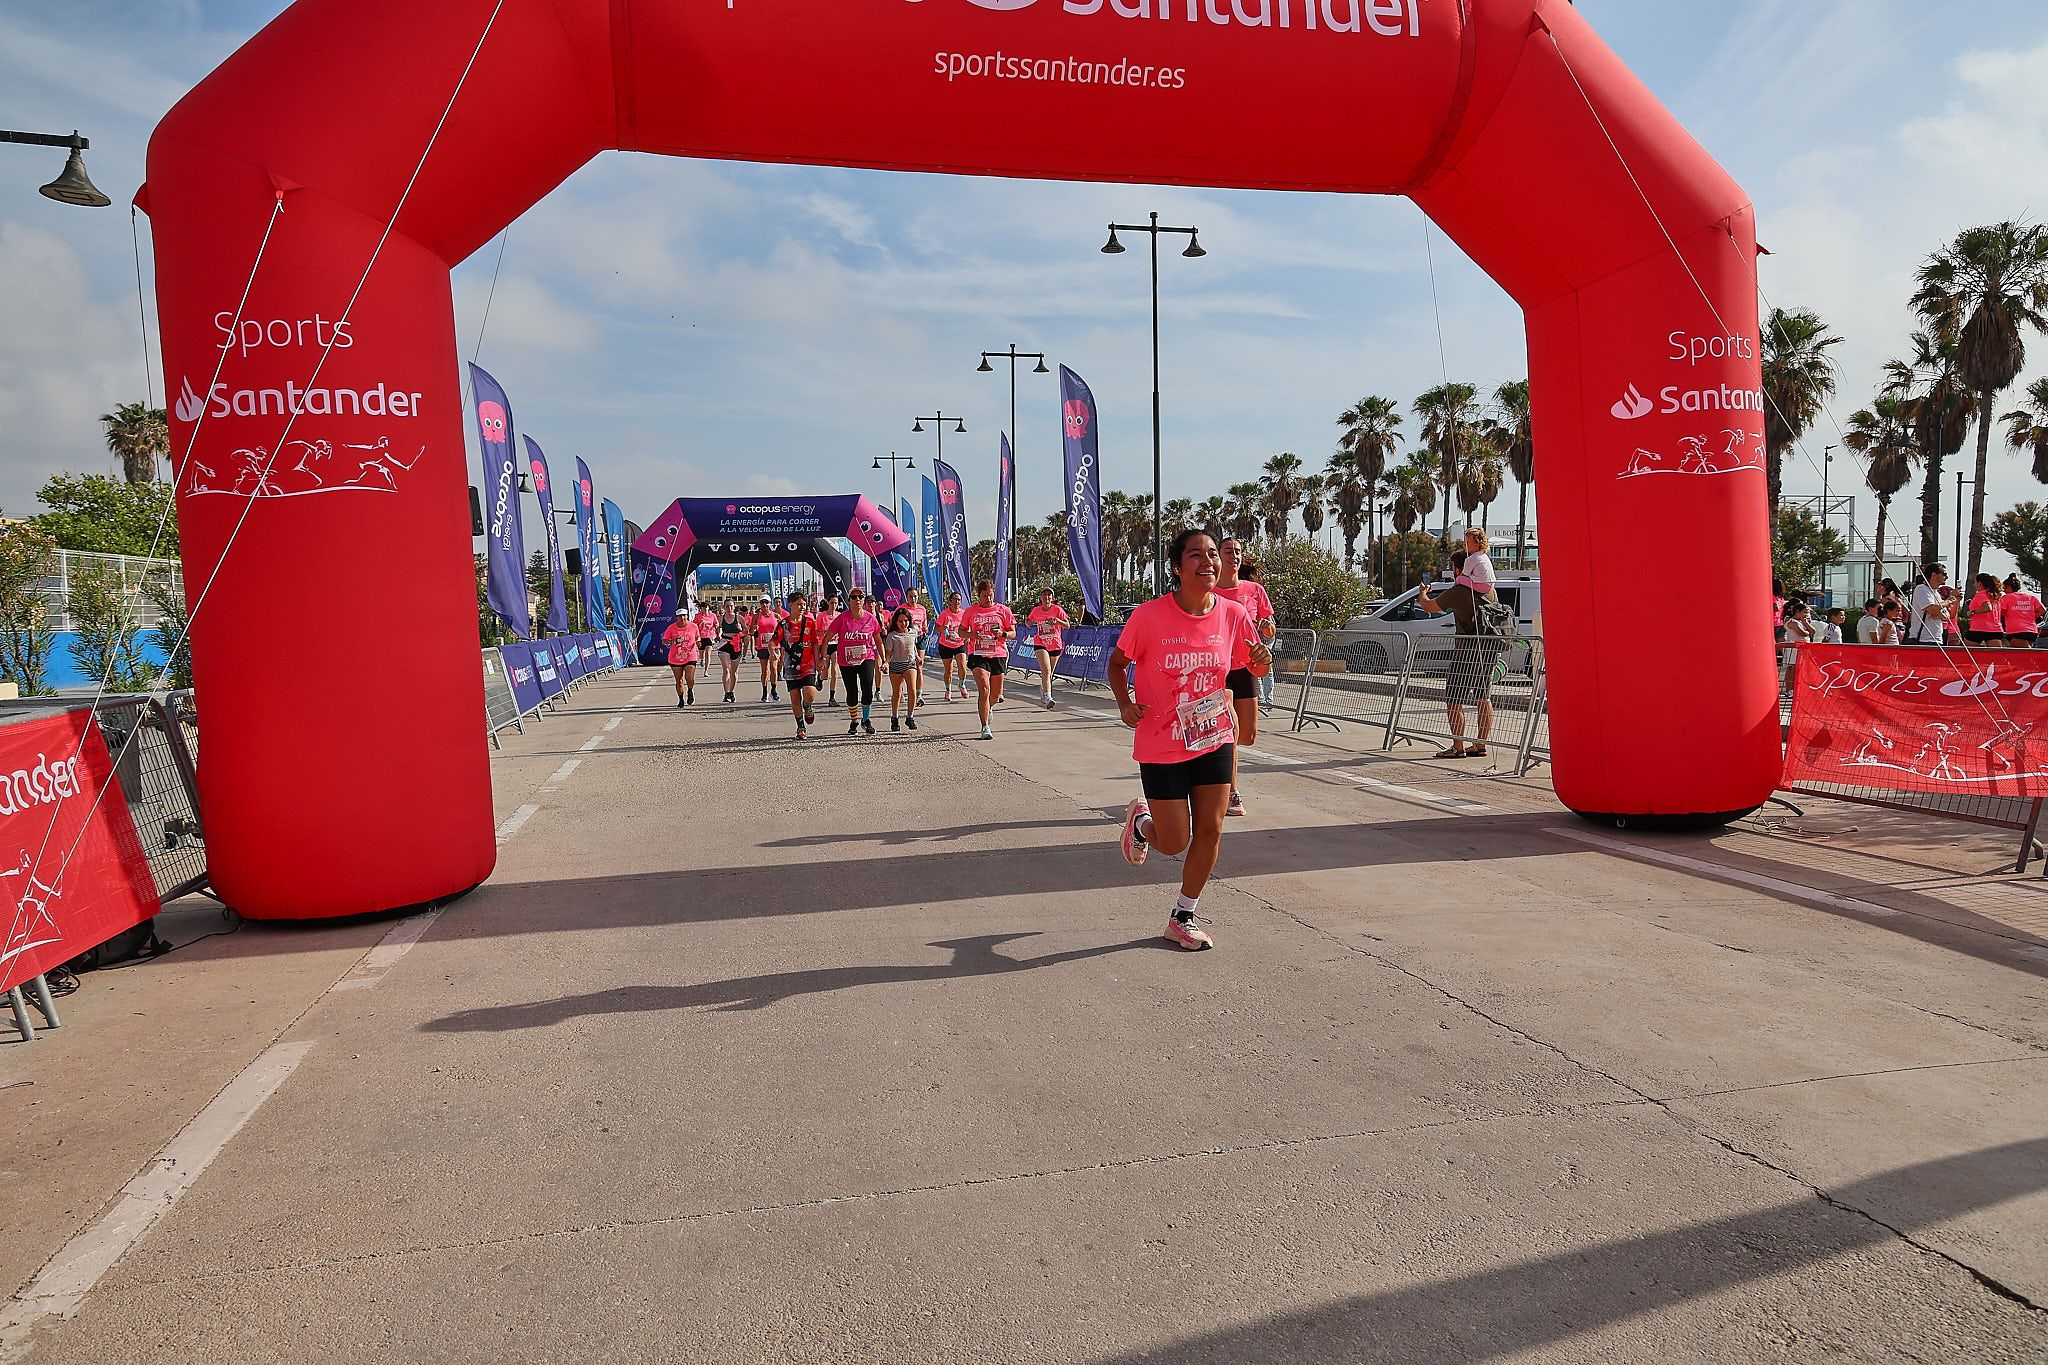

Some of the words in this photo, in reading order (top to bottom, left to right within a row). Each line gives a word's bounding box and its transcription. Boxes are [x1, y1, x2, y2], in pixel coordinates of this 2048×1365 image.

[934, 51, 1186, 89] sportssantander.es
[214, 311, 354, 357] Sports
[1668, 331, 1752, 366] Sports
[211, 380, 422, 418] Santander
[1660, 382, 1764, 414] Santand
[740, 504, 781, 515] octopus
[781, 504, 816, 516] energy
[708, 542, 798, 552] VOLVO
[1161, 636, 1187, 646] OYSHO
[1165, 652, 1221, 669] CARRERA
[1809, 660, 1939, 698] Sports
